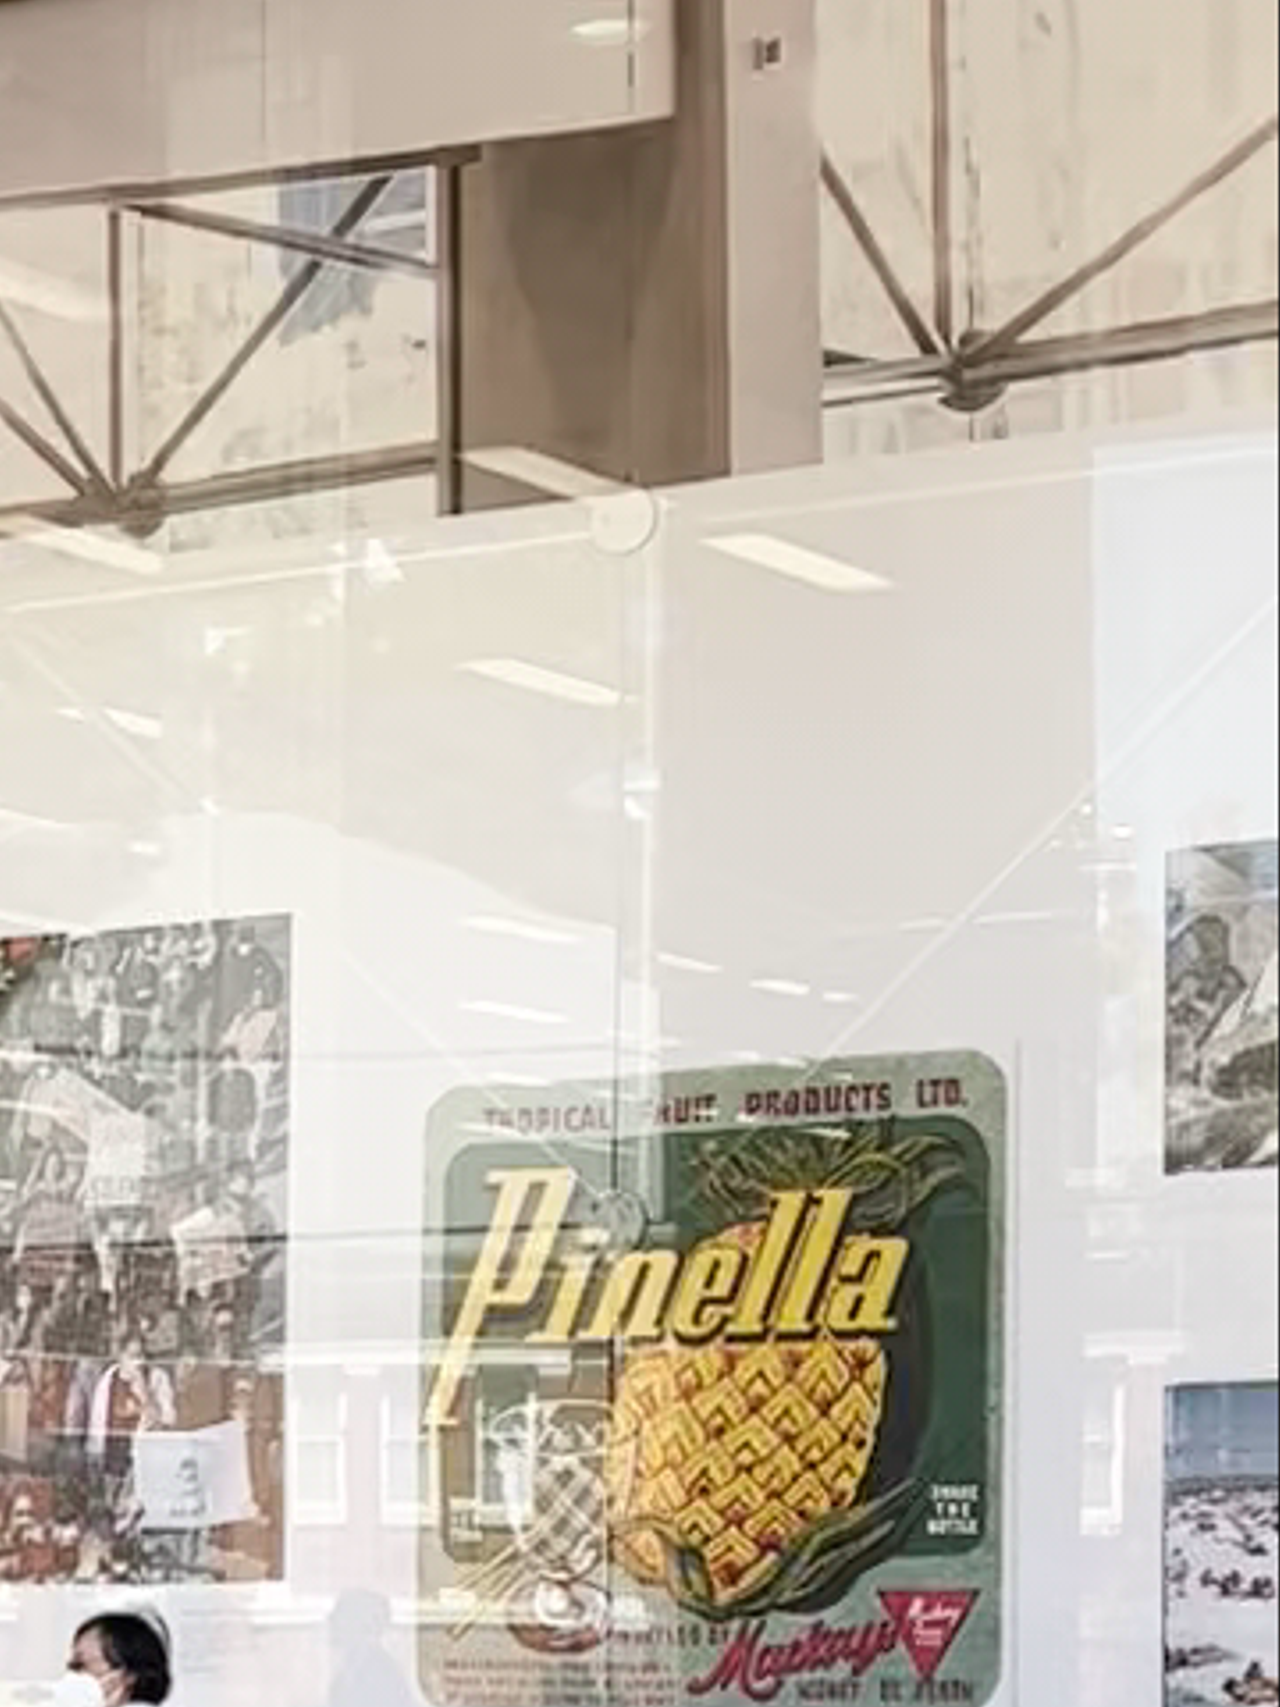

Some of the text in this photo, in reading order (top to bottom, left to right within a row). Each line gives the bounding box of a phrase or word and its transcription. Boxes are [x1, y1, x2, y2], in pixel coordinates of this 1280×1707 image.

[642, 1093, 719, 1127] RUIT
[743, 1081, 893, 1117] PRODUCTS
[424, 1165, 908, 1426] Pinella
